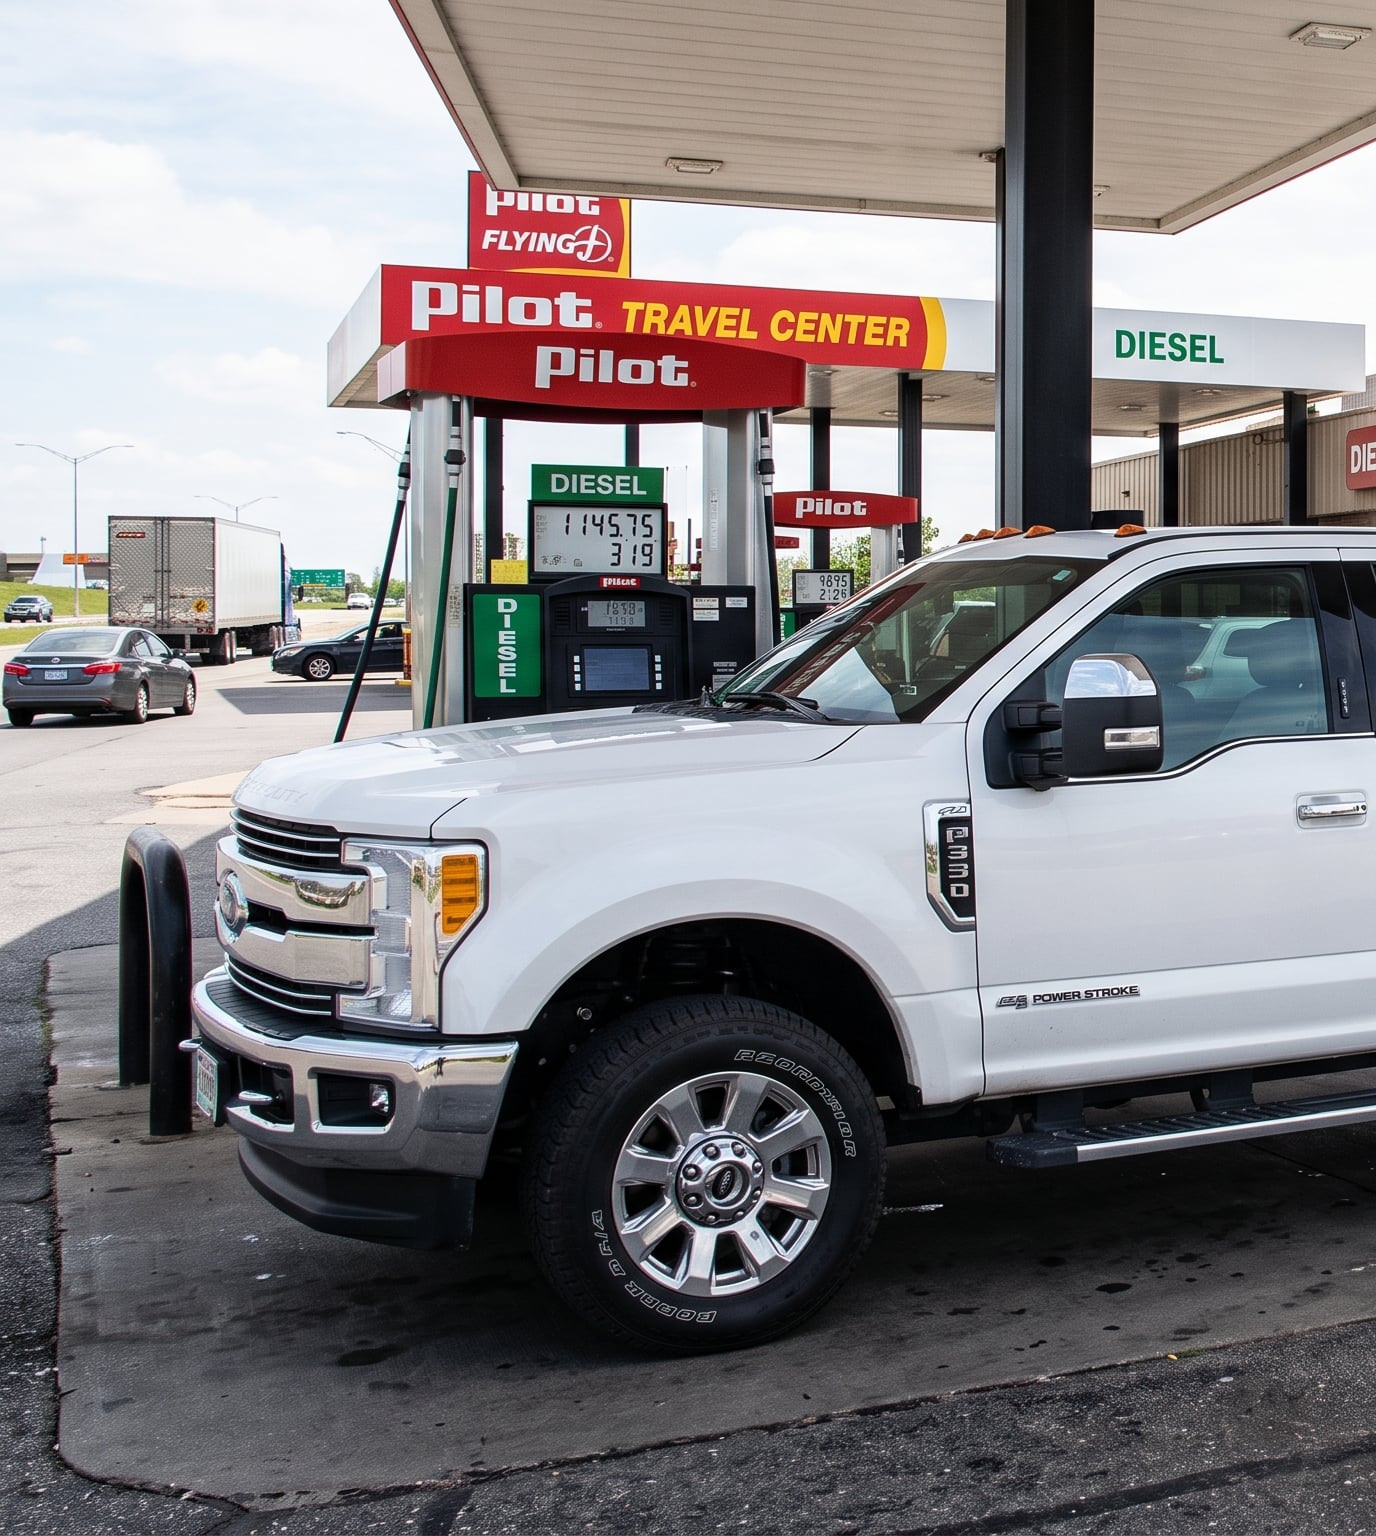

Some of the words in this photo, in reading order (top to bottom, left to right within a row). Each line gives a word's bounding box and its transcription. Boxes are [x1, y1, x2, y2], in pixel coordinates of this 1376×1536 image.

[482, 229, 577, 254] FLYING
[411, 280, 593, 331] Pilot
[622, 301, 758, 340] TRAVEL
[770, 309, 911, 347] CENTER
[1115, 329, 1225, 364] DIESEL
[535, 345, 689, 389] Pilot
[550, 473, 648, 496] DIESEL
[795, 497, 867, 519] Pilot
[497, 598, 518, 693] DIESEL
[1032, 989, 1081, 1004] POWER
[1084, 985, 1140, 999] STROKE
